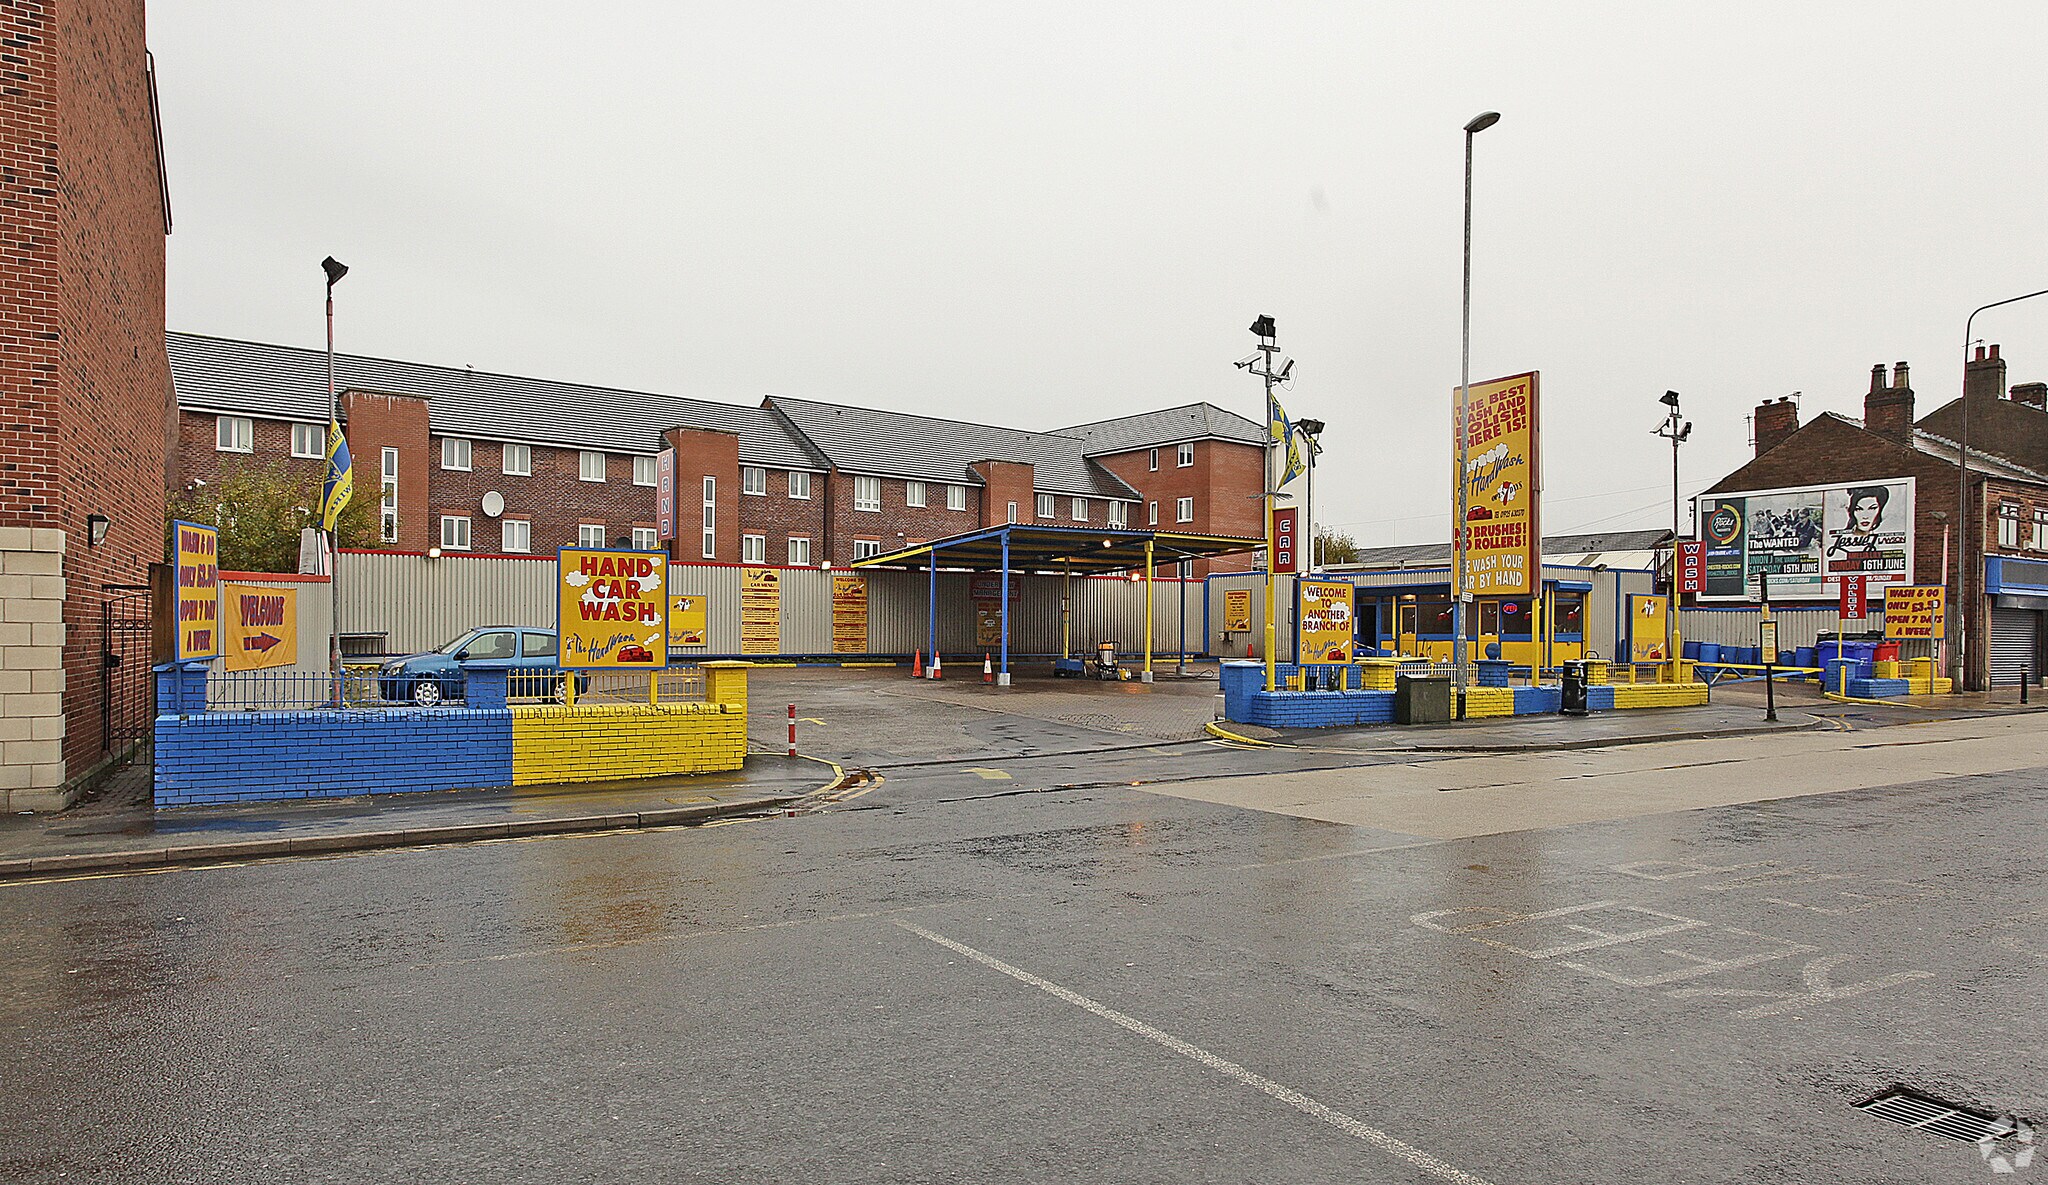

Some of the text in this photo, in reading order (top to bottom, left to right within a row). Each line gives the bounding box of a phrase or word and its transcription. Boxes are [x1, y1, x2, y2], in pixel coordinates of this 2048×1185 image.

[1489, 384, 1526, 404] BEST
[1497, 395, 1526, 413] AND
[1506, 416, 1526, 433] IS!
[661, 454, 670, 536] HAND
[1474, 522, 1527, 538] BRUSHES!
[1278, 519, 1291, 565] CAR
[1475, 535, 1527, 550] ROLLERS!
[1763, 537, 1799, 548] WANTED
[580, 556, 653, 578] HAND
[1458, 554, 1524, 574] E WASH YOUR
[1683, 543, 1701, 590] WASH
[1749, 555, 1769, 565] UNION
[1783, 564, 1800, 573] 15TH
[1801, 562, 1818, 573] JUNE
[1829, 559, 1905, 571] SUNDAY 16TH JUNE
[1479, 571, 1492, 589] BY
[1495, 570, 1523, 587] HAND
[592, 578, 641, 600] CAR
[1306, 586, 1347, 598] WELCOME
[1889, 589, 1915, 598] WASH
[1917, 589, 1924, 597] &
[240, 594, 285, 627] WELCOME
[1321, 599, 1332, 608] TO
[1887, 601, 1910, 610] ONLY
[578, 601, 655, 622] WASH
[1307, 609, 1346, 620] ANOTHER
[1302, 621, 1350, 631] BRANCH OF
[1885, 615, 1909, 624] OPEN
[1911, 615, 1918, 624] 7
[1896, 627, 1932, 636] A WEEK
